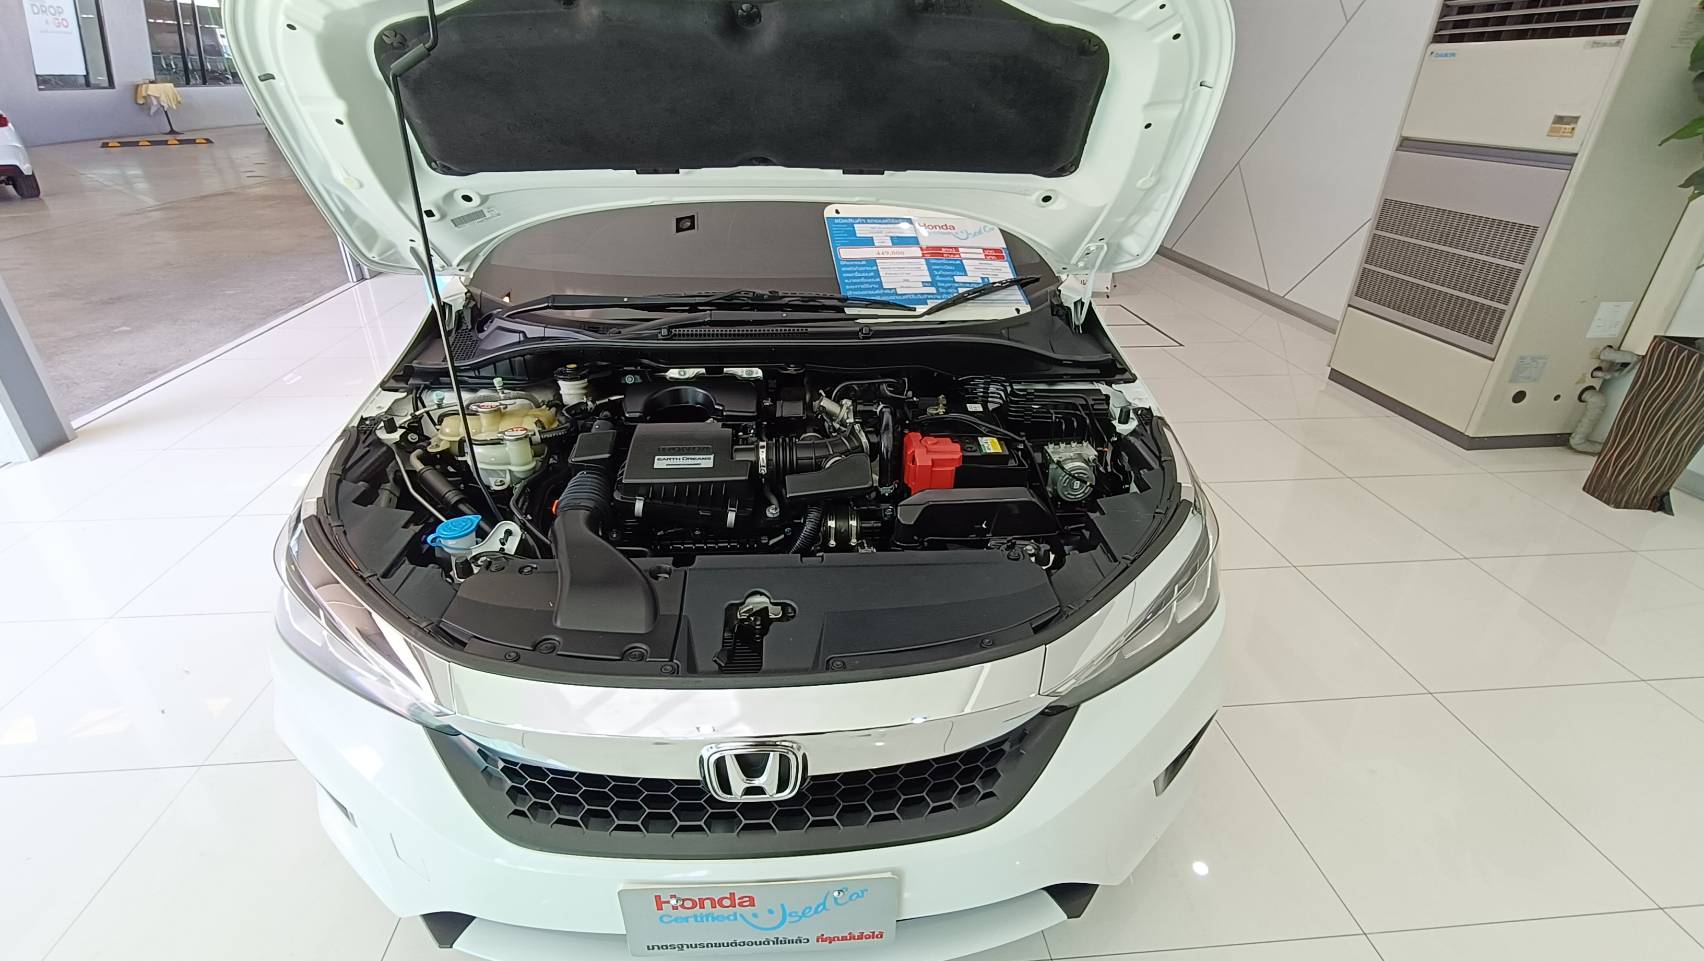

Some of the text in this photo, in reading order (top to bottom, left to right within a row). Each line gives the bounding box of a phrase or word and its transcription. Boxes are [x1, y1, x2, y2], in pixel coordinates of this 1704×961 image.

[31, 4, 64, 16] DROP
[53, 17, 69, 28] GO
[919, 223, 956, 231] Honda
[654, 892, 756, 911] Honda
[739, 886, 868, 931] Used Car
[659, 911, 738, 925] Certified
